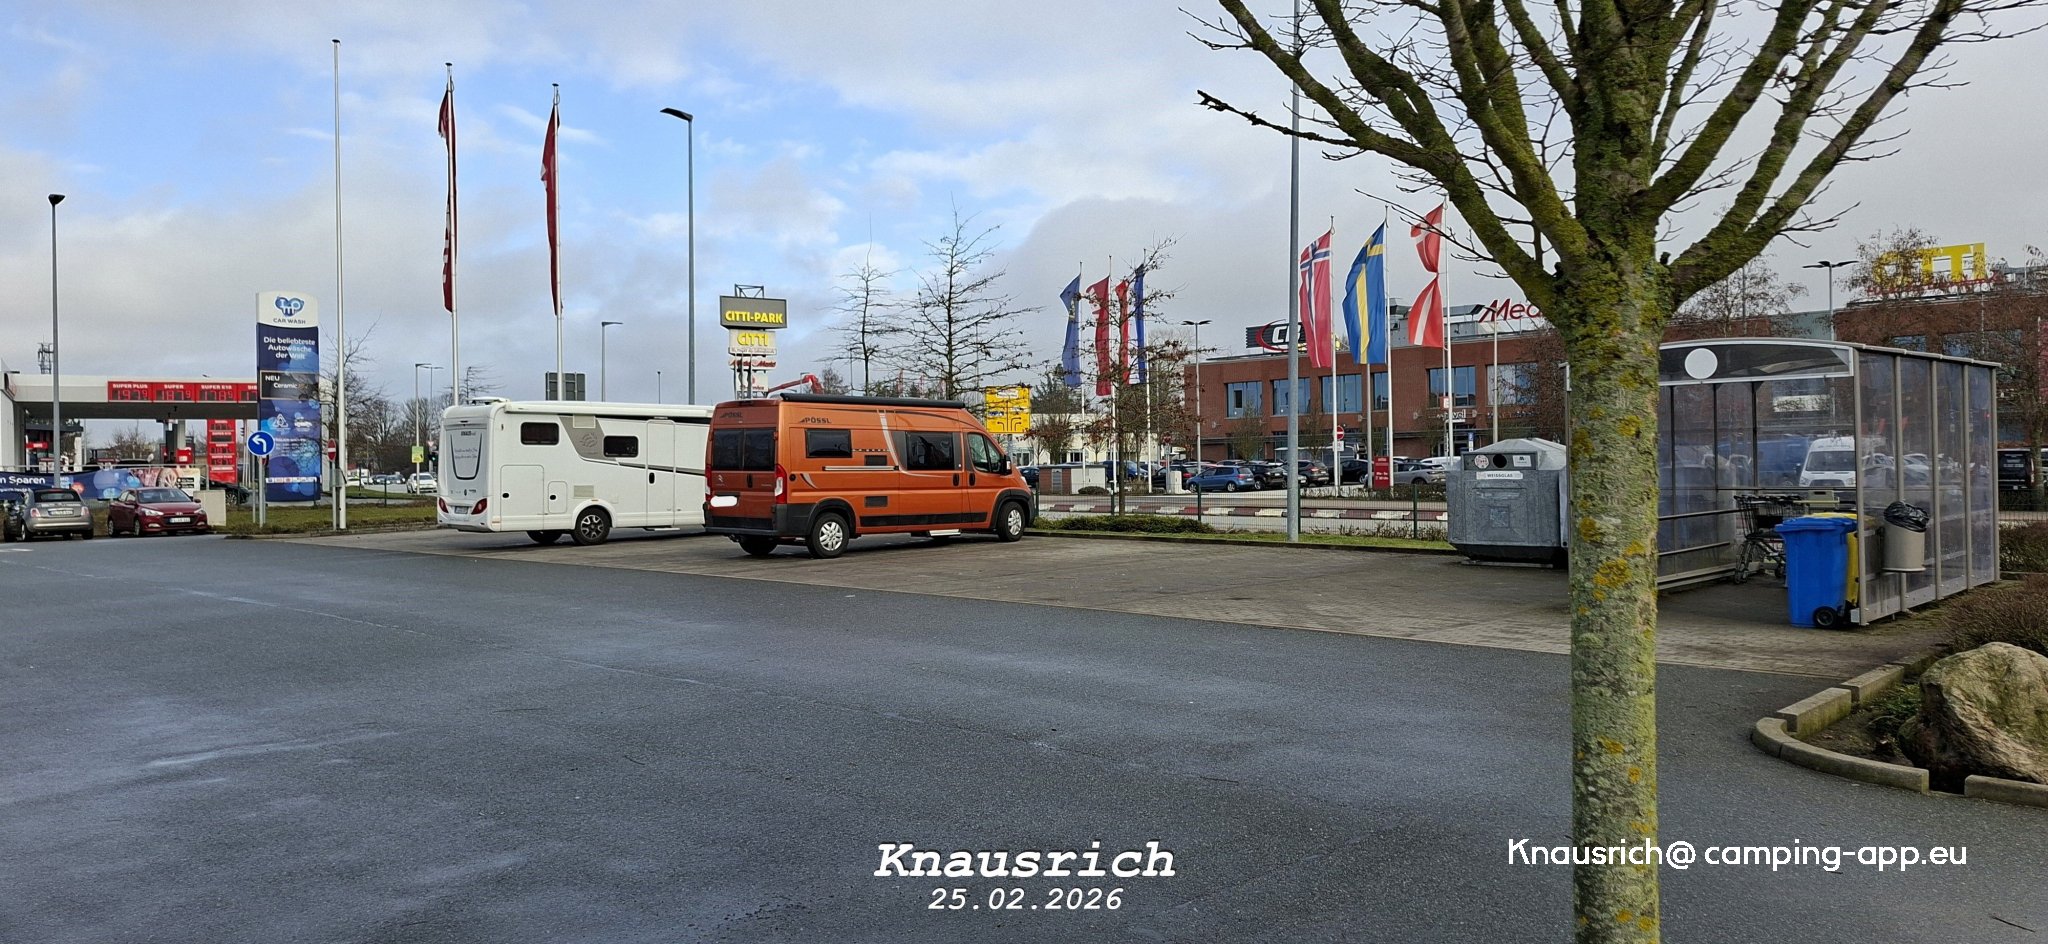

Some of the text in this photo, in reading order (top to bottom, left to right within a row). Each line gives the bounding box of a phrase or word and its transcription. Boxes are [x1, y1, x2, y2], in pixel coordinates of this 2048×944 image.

[725, 311, 783, 324] CITTI-PARK
[277, 337, 316, 345] beliebteste
[737, 333, 769, 346] CITTI
[9, 475, 46, 485] Sparen
